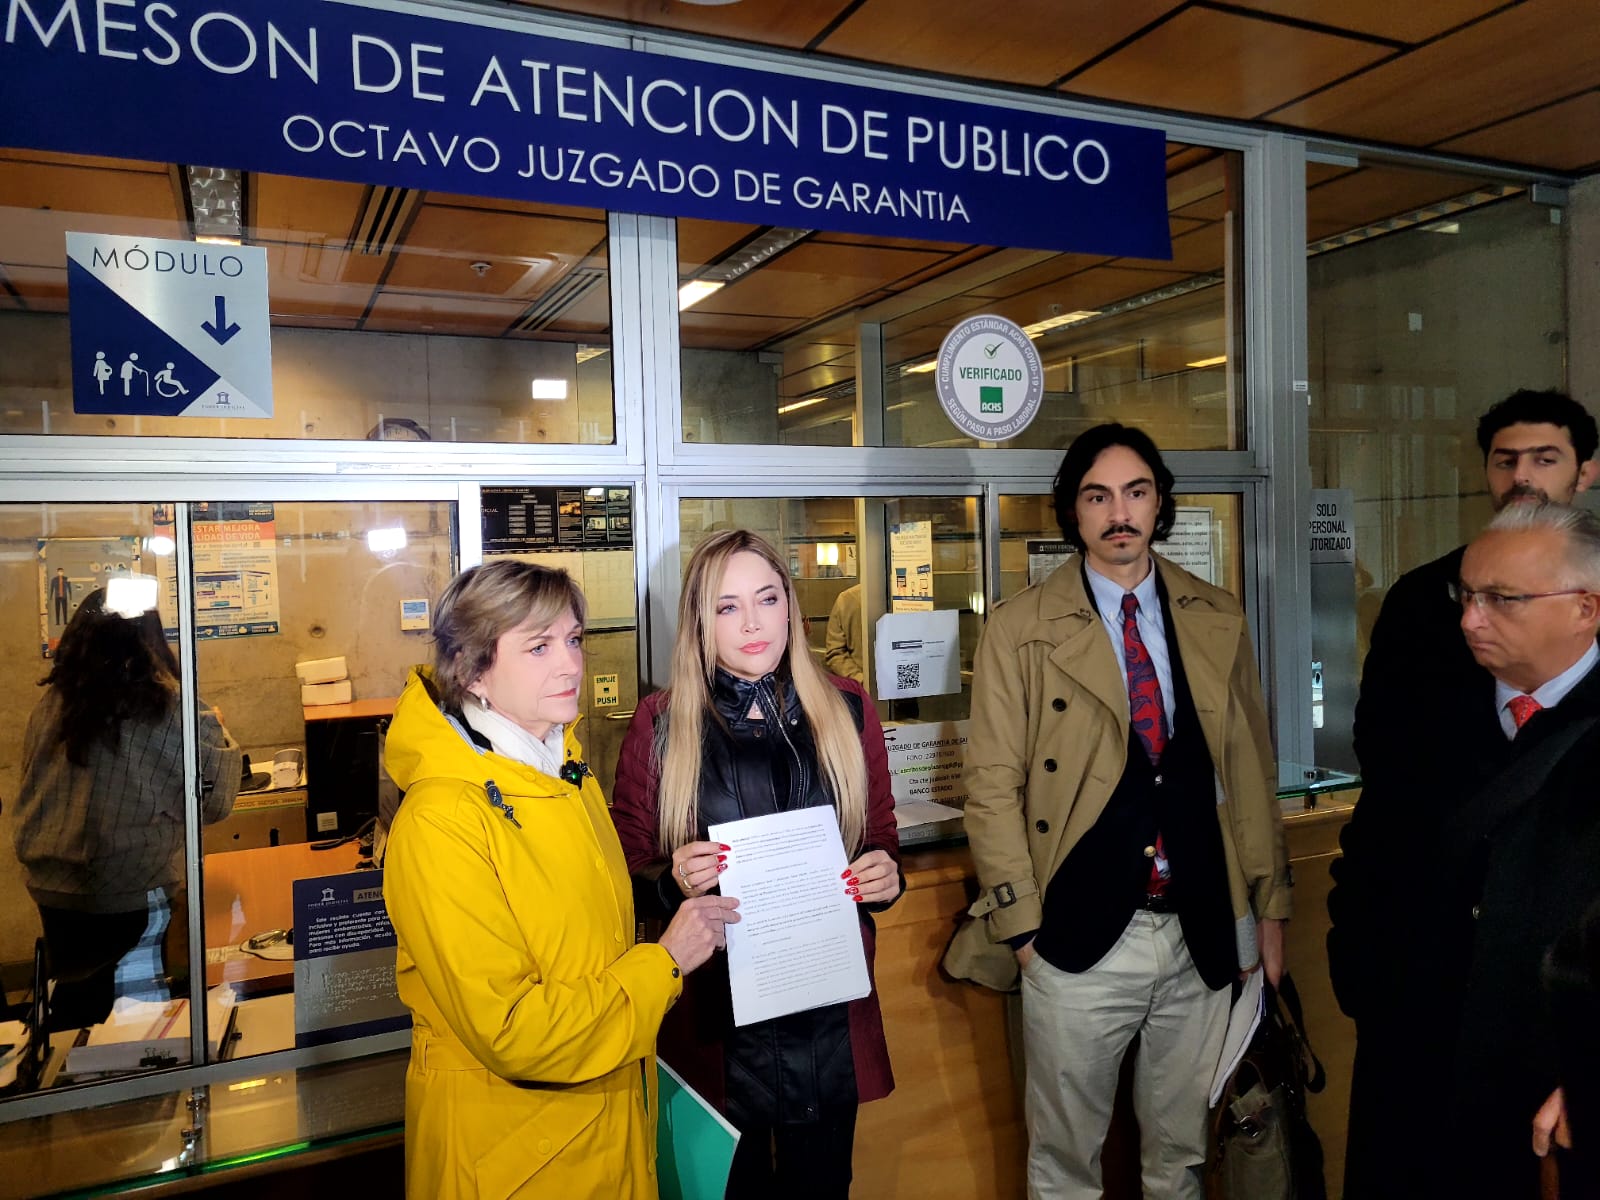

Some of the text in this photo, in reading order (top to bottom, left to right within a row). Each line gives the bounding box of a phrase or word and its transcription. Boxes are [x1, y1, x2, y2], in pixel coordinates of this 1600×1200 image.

[6, 0, 1110, 185] MESON DE ATENCION DE PUBLICO
[282, 114, 970, 223] OCTAVO JUZGADO DE GARANTIA
[92, 245, 243, 278] MÓDULO
[941, 326, 971, 383] CUMPLIMIENTO
[1008, 329, 1026, 348] ACHS
[959, 366, 1023, 381] VERIFICADO
[981, 402, 1002, 412] ACHS
[966, 419, 986, 434] PASO
[986, 427, 993, 436] A
[993, 423, 1013, 436] PASO
[1012, 399, 1037, 429] LABORAL
[1316, 503, 1337, 517] SOLO
[223, 523, 261, 532] MEJORA
[225, 533, 239, 541] DE
[240, 532, 261, 540] VIDA
[596, 696, 617, 705] PUSH
[909, 785, 953, 795] BANCO ESTADO
